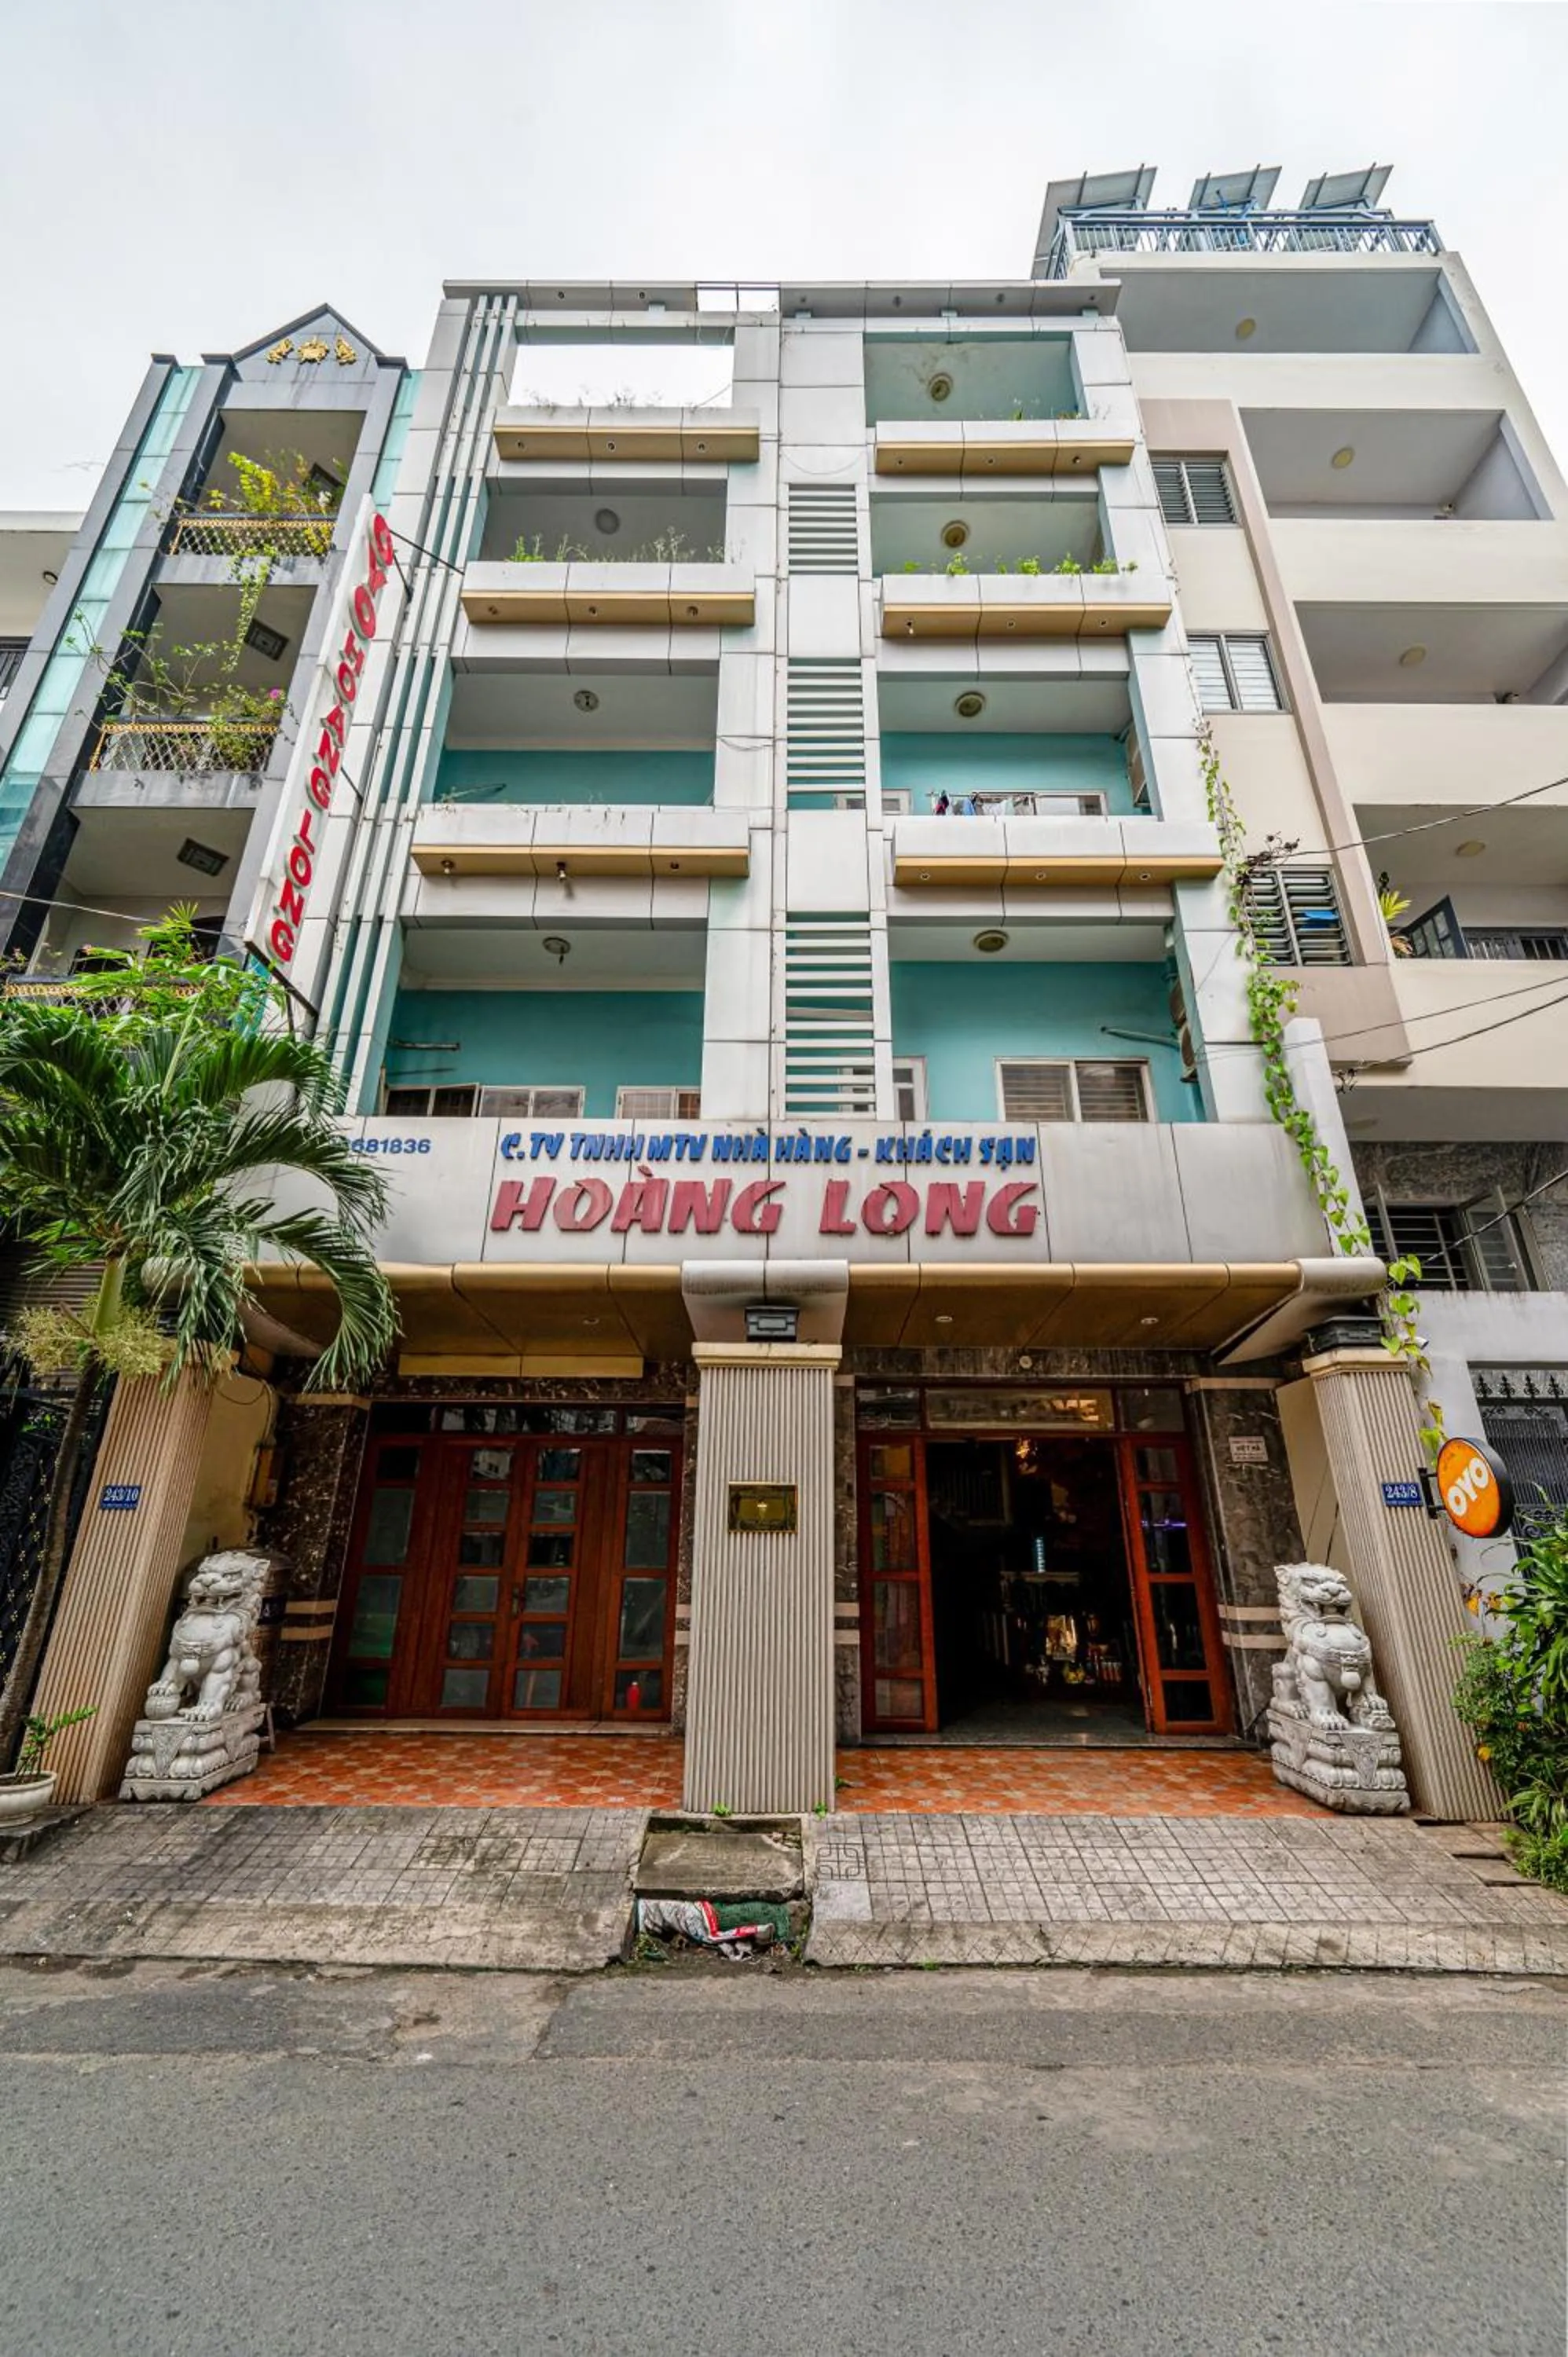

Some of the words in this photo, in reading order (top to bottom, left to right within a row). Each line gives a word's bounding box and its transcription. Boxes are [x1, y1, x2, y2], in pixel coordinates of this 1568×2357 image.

[353, 511, 394, 639] OYO
[270, 808, 316, 962] LONG
[344, 1138, 431, 1154] 681836
[570, 1132, 646, 1161] TNHH
[647, 1134, 708, 1162] MTV
[711, 1127, 770, 1163] NHÀ
[775, 1127, 852, 1164] HÀNG
[874, 1129, 973, 1164] KHÁCH
[979, 1136, 1036, 1171] SẠN
[489, 1164, 786, 1234] HOÀNG
[819, 1180, 1039, 1236] LONG
[1448, 1457, 1489, 1517] OYO
